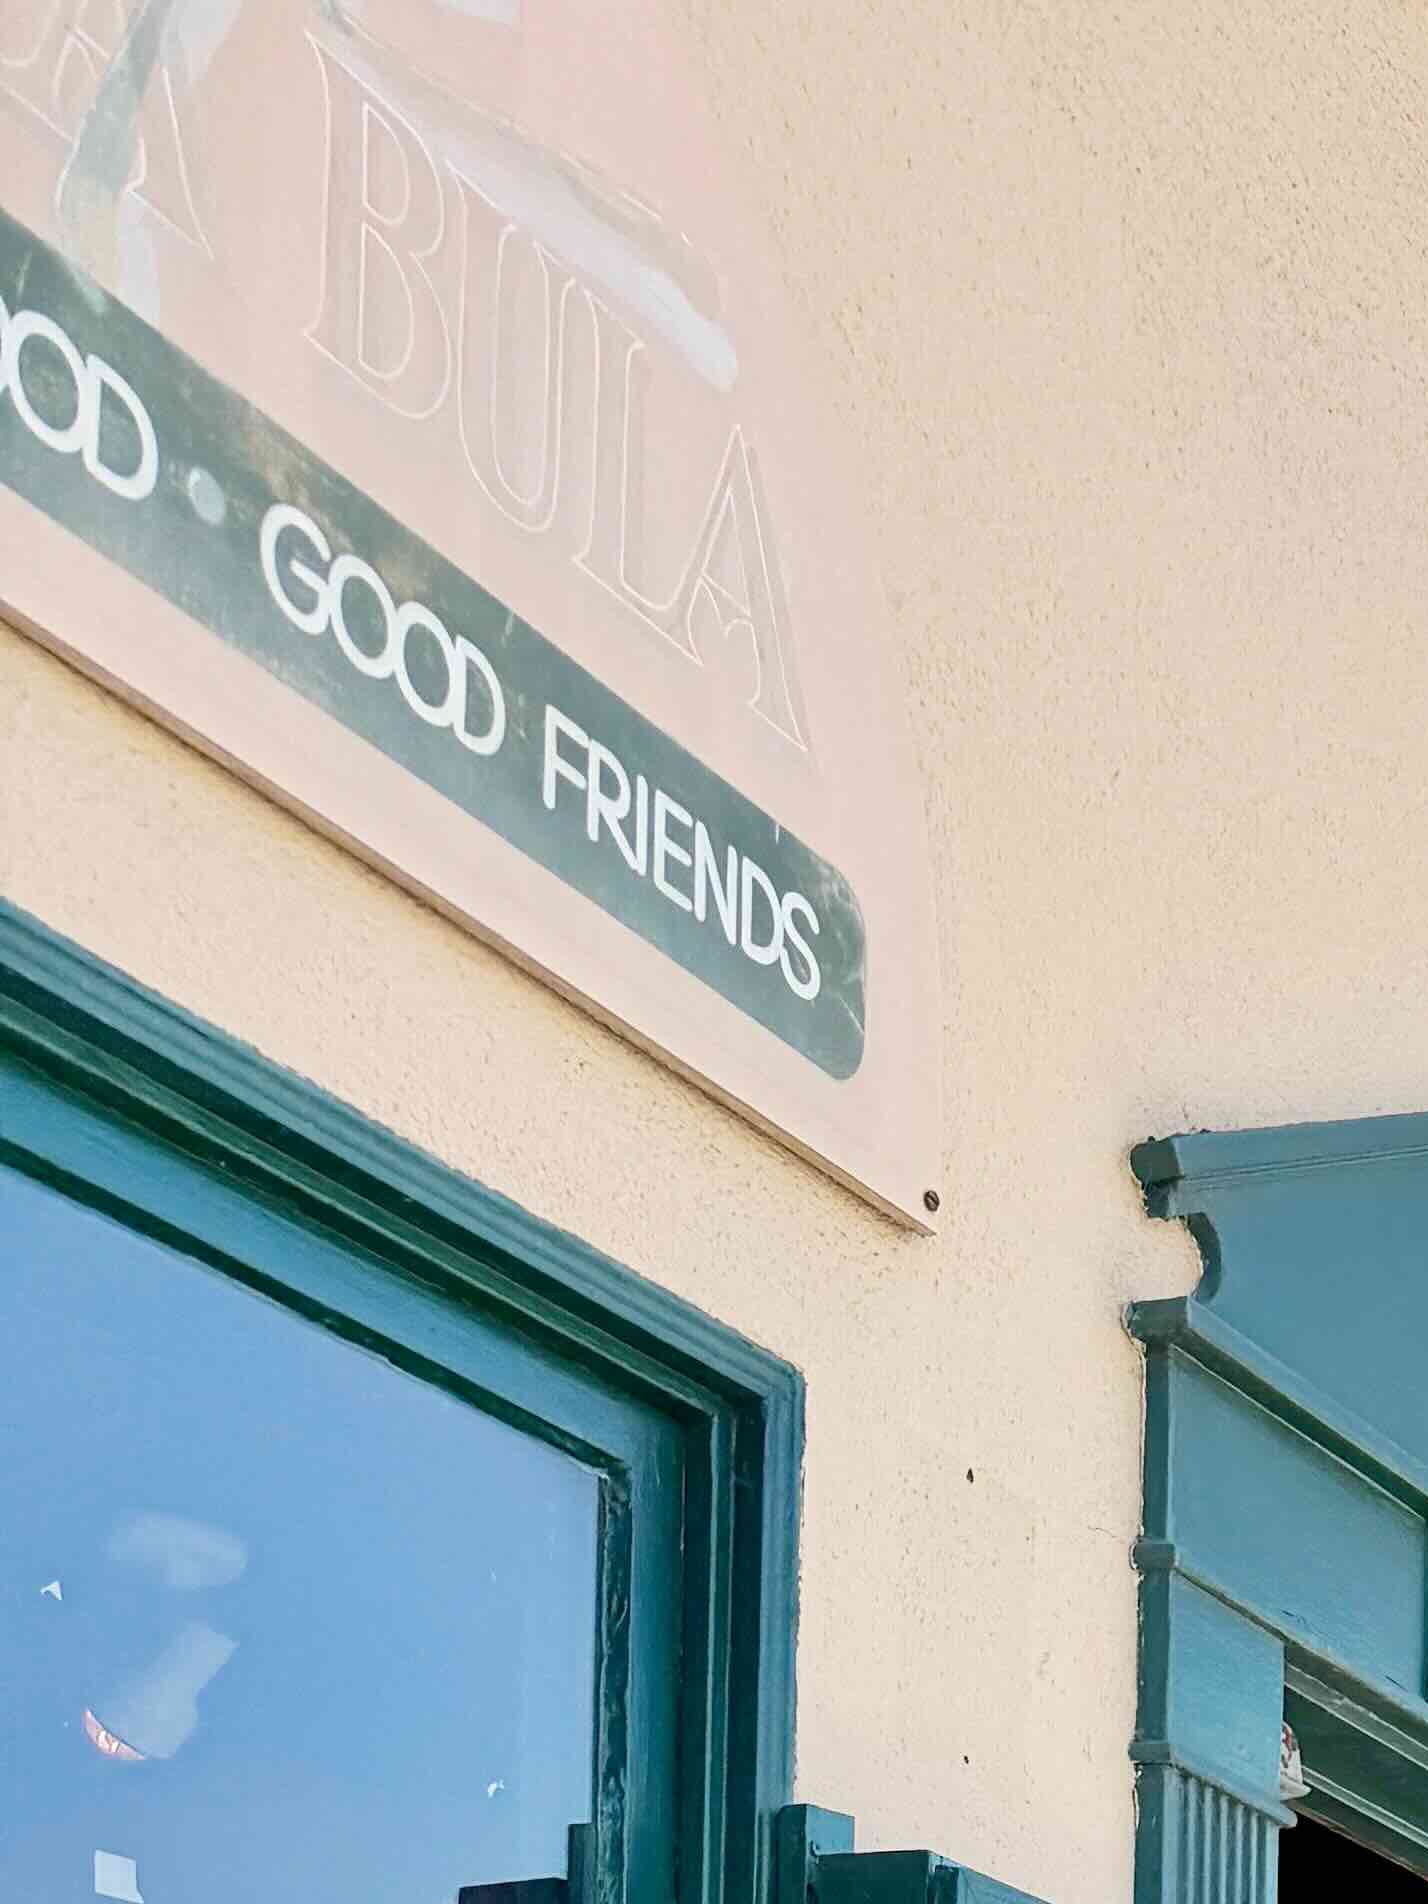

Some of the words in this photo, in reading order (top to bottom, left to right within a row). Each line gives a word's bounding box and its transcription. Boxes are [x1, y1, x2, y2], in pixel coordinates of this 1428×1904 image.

[0, 300, 158, 501] OD
[259, 502, 507, 758] GOOD
[540, 704, 823, 1002] FRIENDS
[307, 30, 810, 754] BULA
